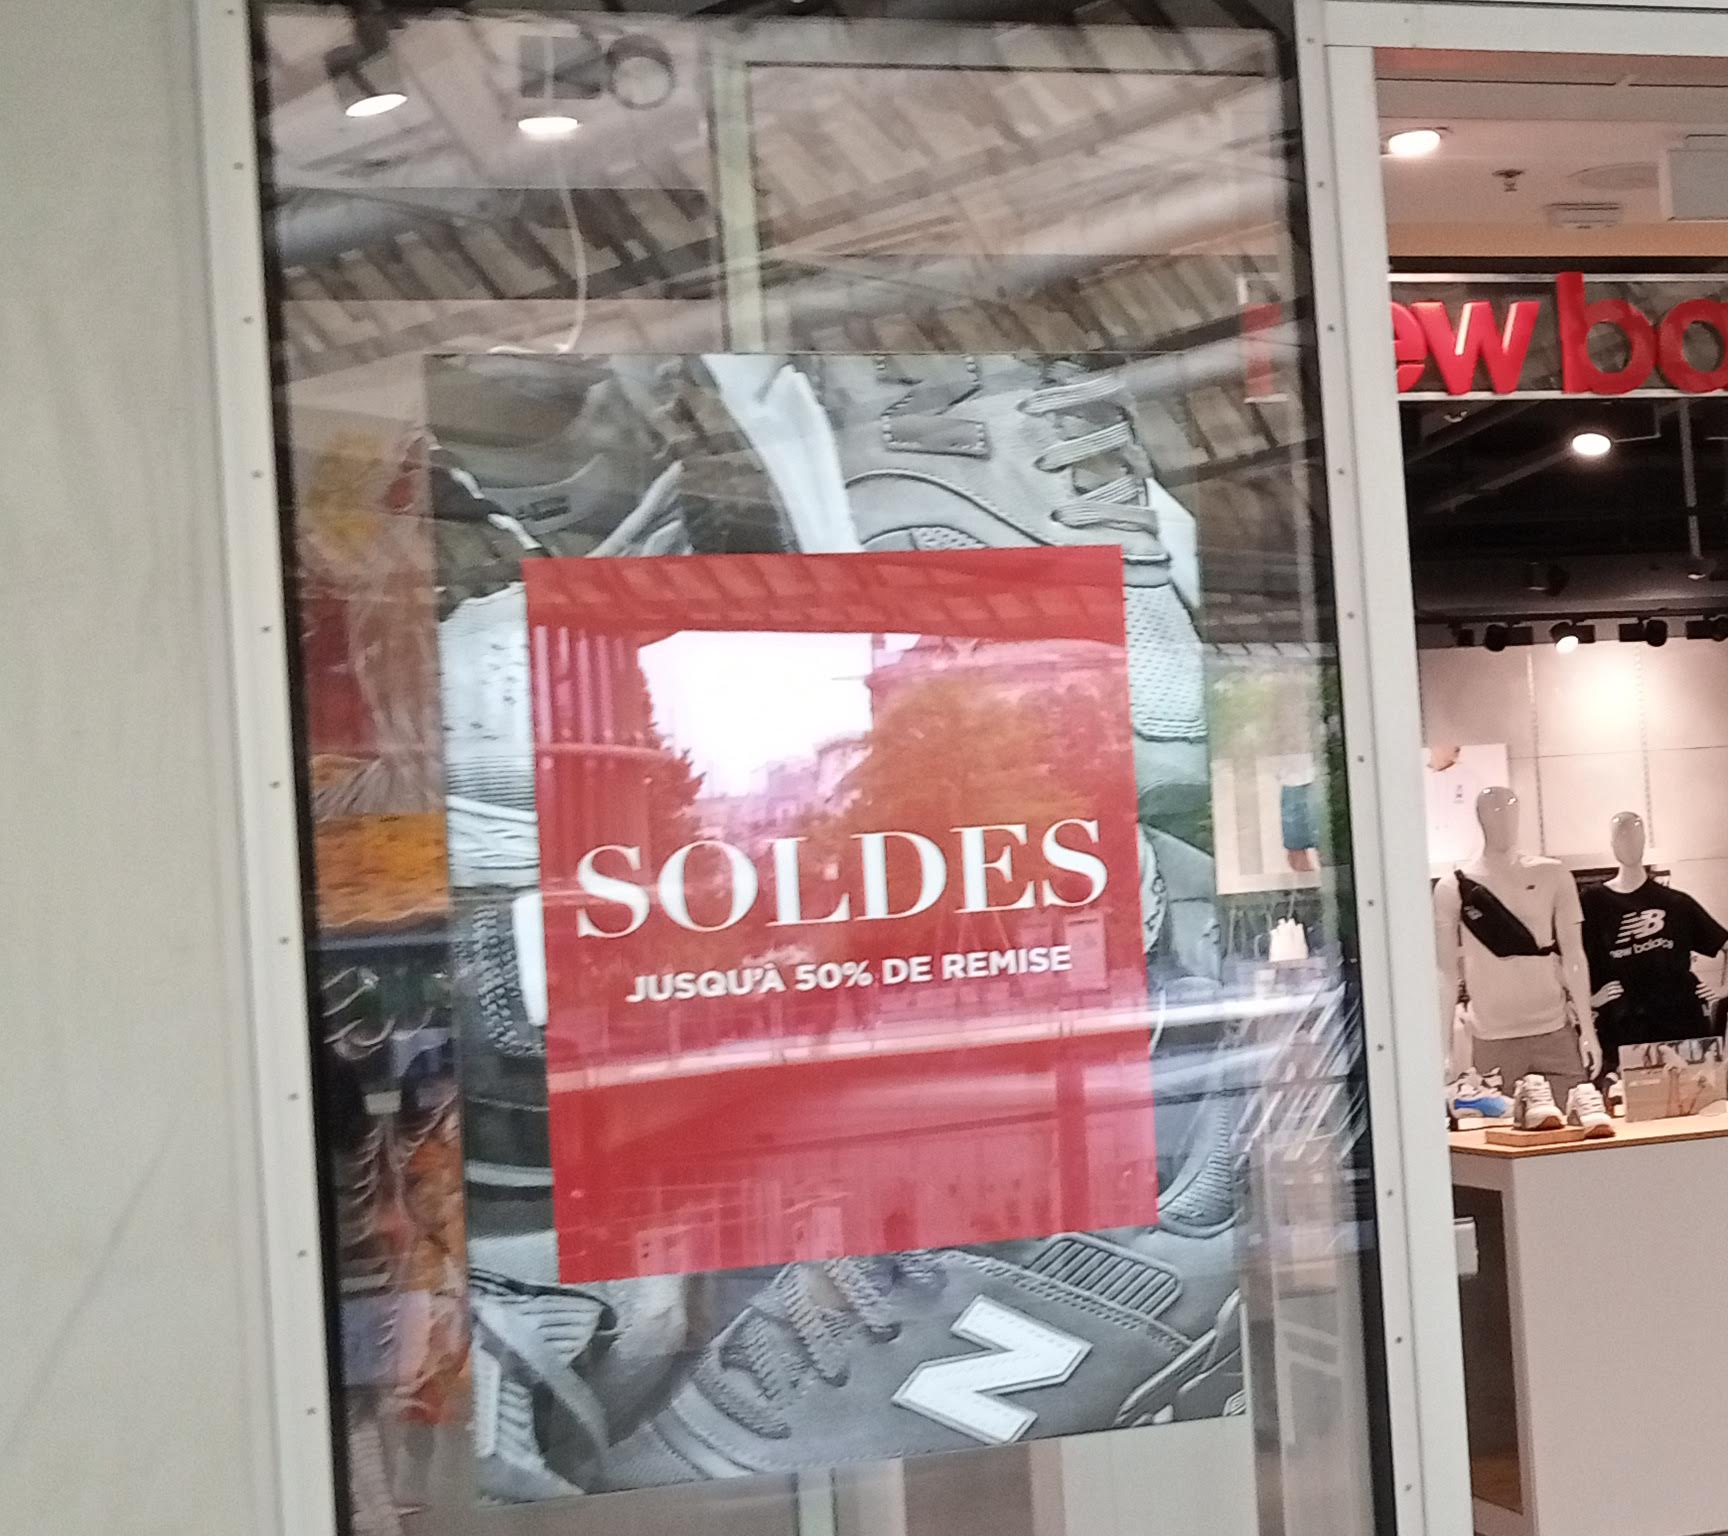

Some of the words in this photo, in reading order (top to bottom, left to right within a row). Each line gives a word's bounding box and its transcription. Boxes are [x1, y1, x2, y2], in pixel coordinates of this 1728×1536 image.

[576, 818, 1109, 939] SOLDES
[794, 959, 874, 992] 50%
[881, 955, 932, 984] DE
[942, 945, 1072, 979] REMISE
